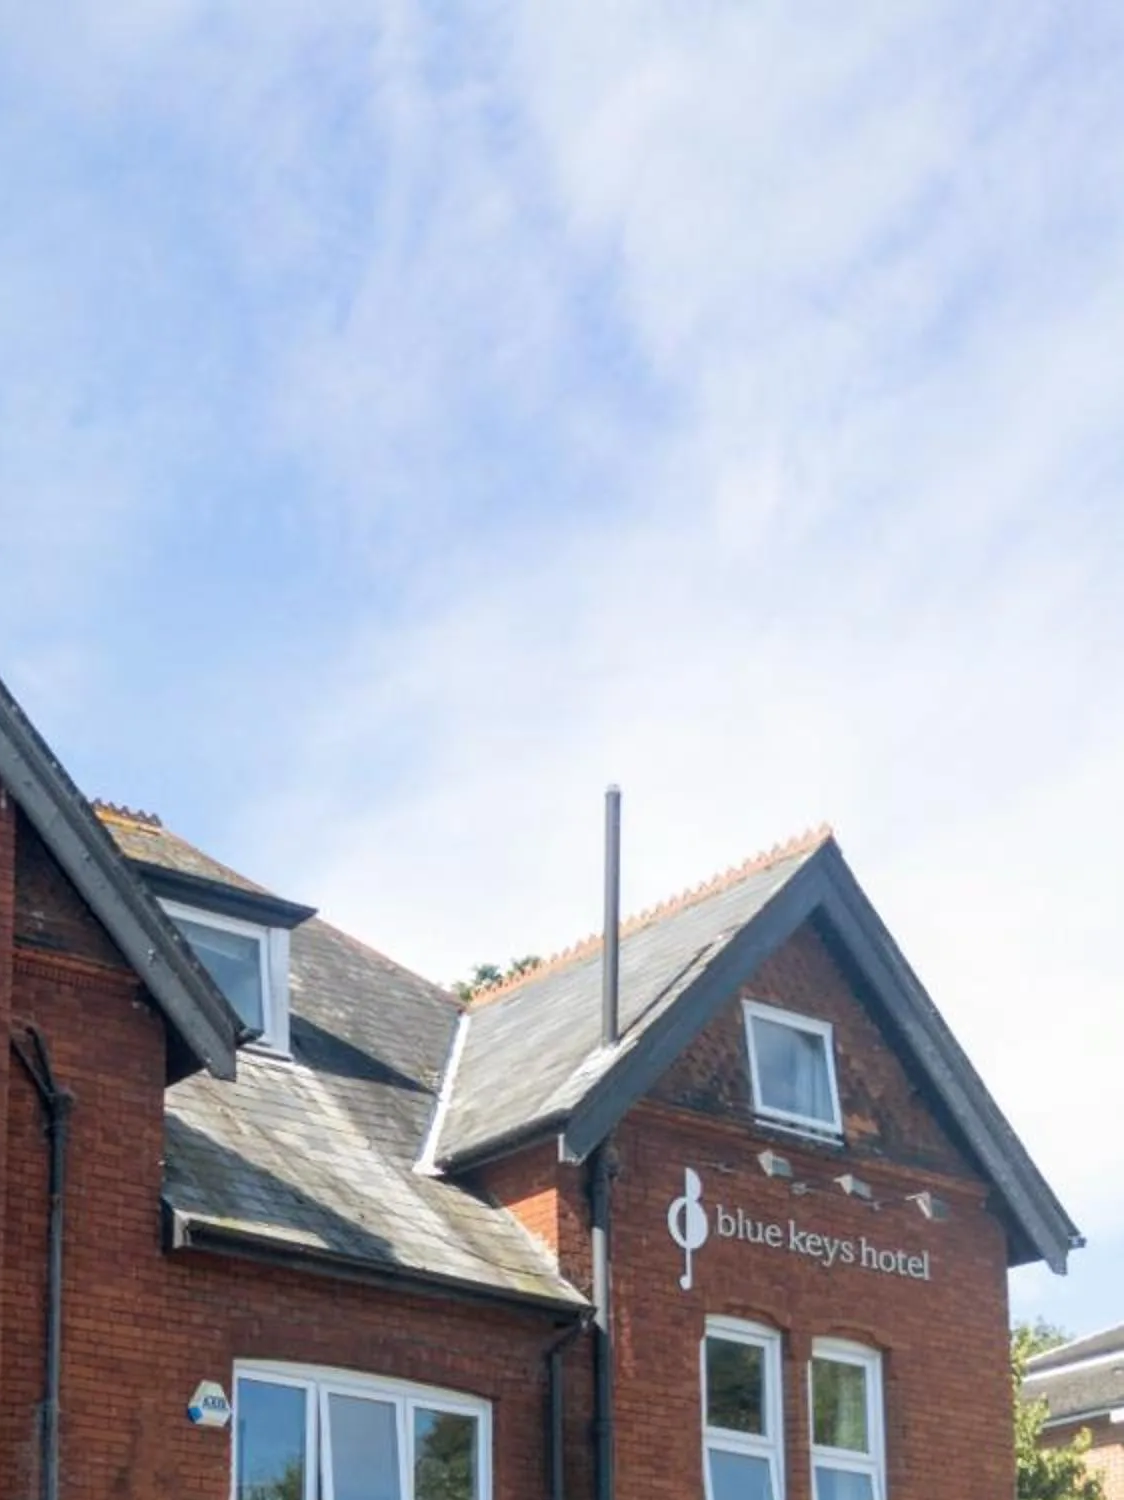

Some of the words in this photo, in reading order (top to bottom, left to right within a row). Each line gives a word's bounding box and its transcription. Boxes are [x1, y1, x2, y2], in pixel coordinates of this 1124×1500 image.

[716, 1204, 781, 1247] blue
[788, 1220, 854, 1266] keys
[860, 1238, 930, 1280] hotel
